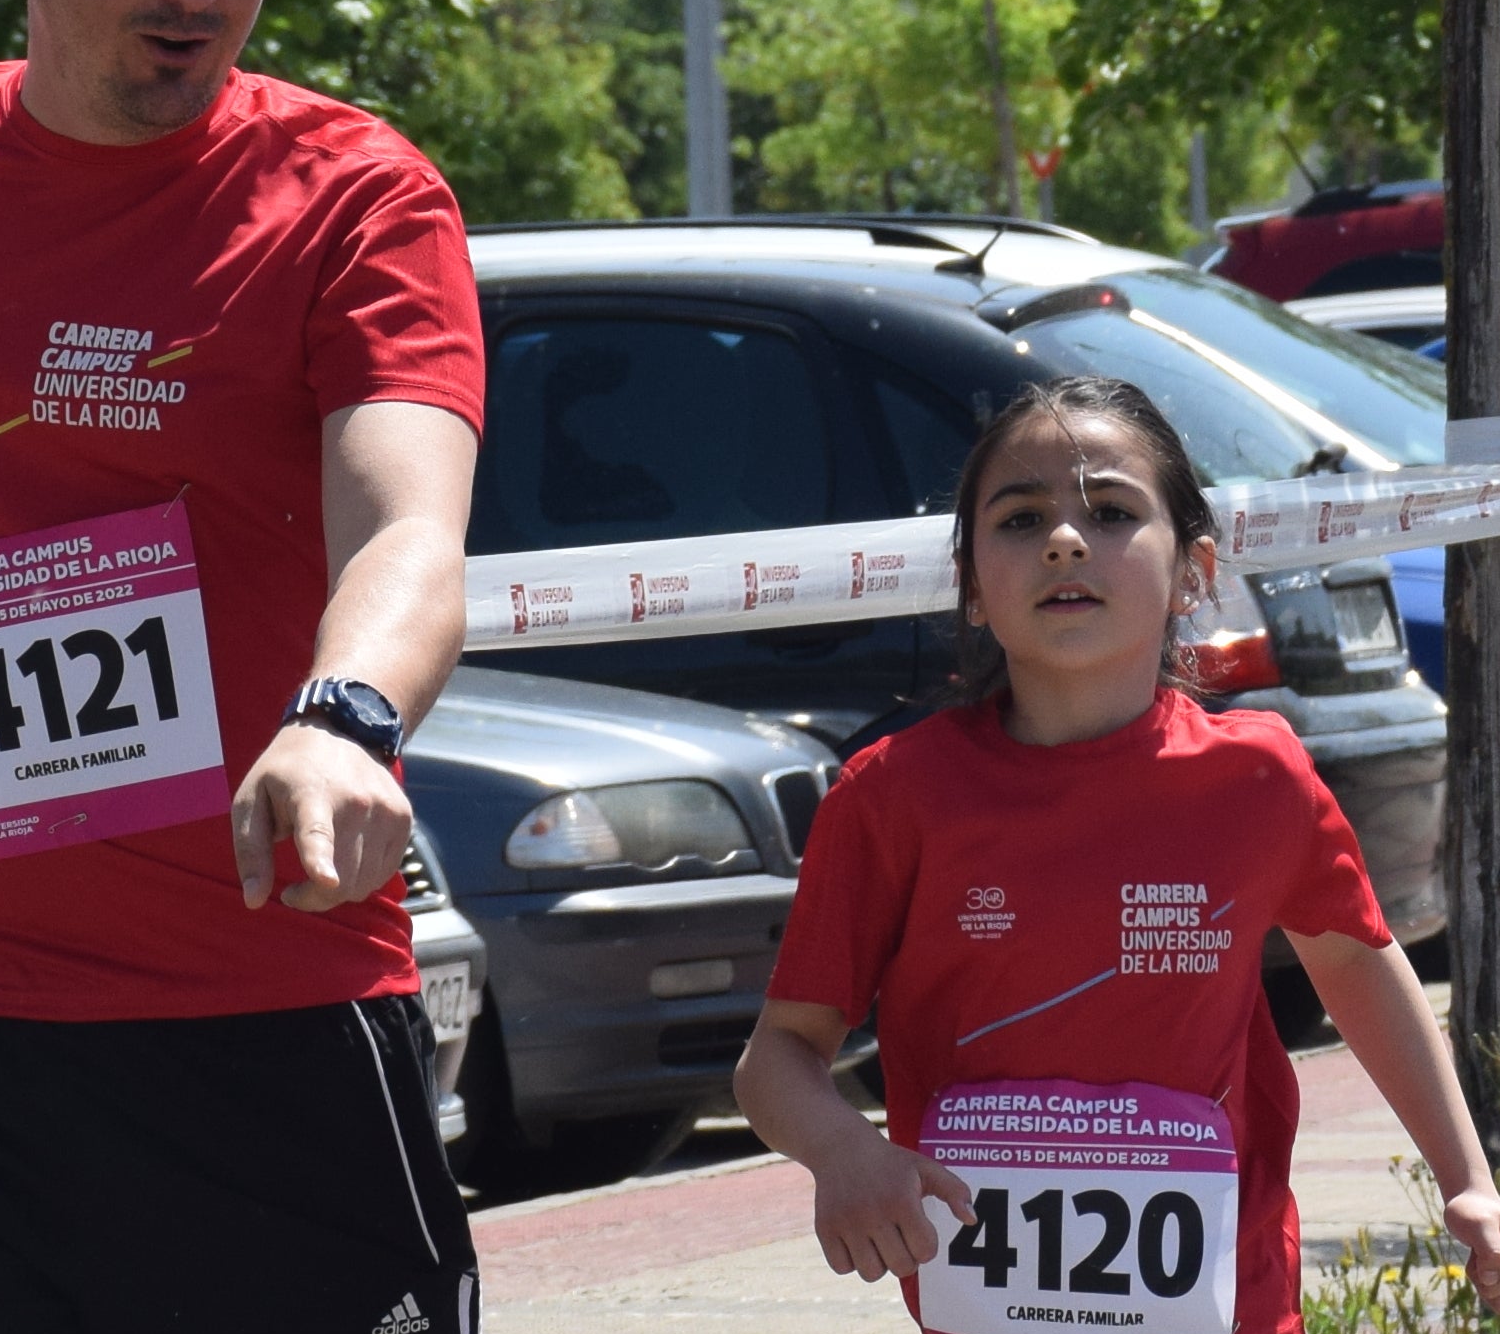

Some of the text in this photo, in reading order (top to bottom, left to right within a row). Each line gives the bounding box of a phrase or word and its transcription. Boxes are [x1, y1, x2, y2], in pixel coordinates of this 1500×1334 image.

[49, 321, 153, 351] CARRERA
[41, 347, 136, 373] CAMPUS
[33, 372, 185, 403] UNIVERSIDAD
[33, 400, 161, 431] DE LA RIOJA
[12, 536, 92, 566] CAMPUS
[54, 561, 81, 579] DE
[84, 555, 113, 573] LA
[116, 541, 178, 567] RIOJA
[10, 606, 27, 619] DE
[30, 596, 70, 615] MAYO
[74, 593, 94, 607] DE
[96, 585, 134, 601] 2022
[15, 743, 146, 780] CARRERA FAMILIAR
[8, 826, 33, 839] RIOJA
[966, 887, 1004, 909] 30
[1121, 884, 1208, 904] CARRERA
[1121, 907, 1200, 927] CAMPUS
[1121, 930, 1231, 950] UNIVERSIDAD
[1121, 954, 1218, 974] DE LA RIOJA
[940, 1095, 1138, 1115] CARRERA CAMPUS
[938, 1115, 1218, 1142] UNIVERSIDAD DE LA RIOJA
[935, 1148, 1169, 1165] DOMINGO 15 DE MAYO DE 2022
[948, 1188, 1203, 1299] 4120
[1007, 1306, 1143, 1325] CARRERA FAMILIAR
